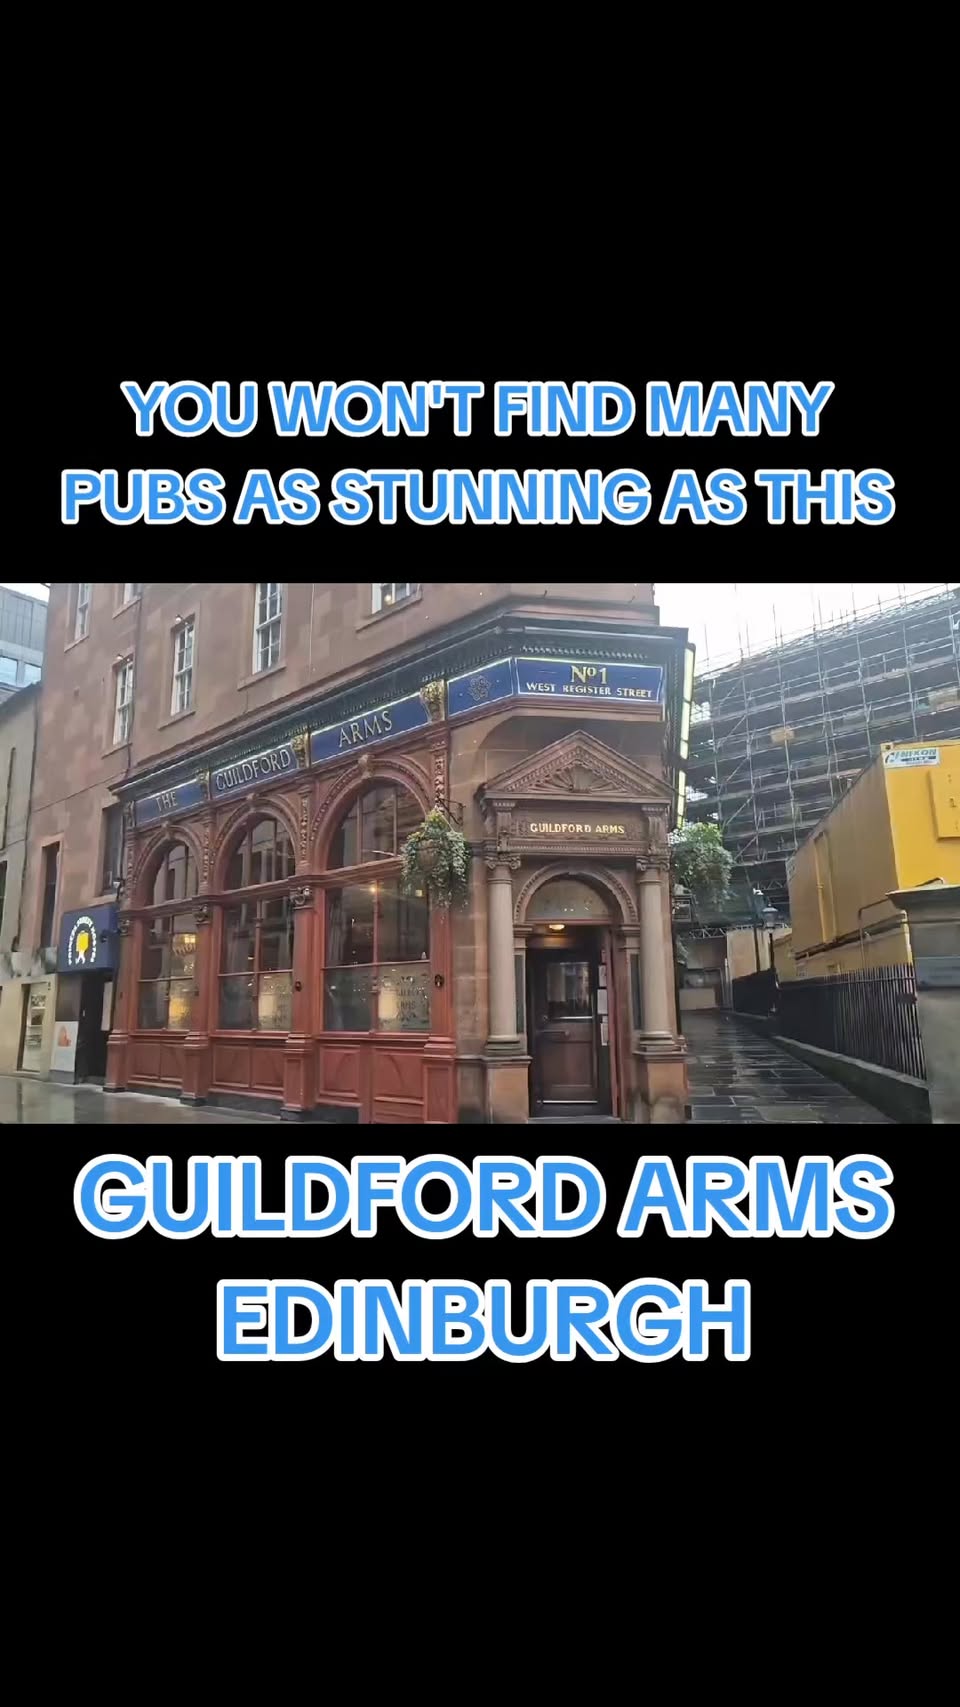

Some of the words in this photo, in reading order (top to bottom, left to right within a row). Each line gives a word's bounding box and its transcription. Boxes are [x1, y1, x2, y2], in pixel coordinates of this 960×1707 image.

[526, 682, 556, 693] WEST
[562, 685, 612, 696] REGISTER
[616, 687, 652, 698] STREET
[155, 790, 176, 812] THE
[215, 748, 292, 791] GUILDFORD
[338, 709, 394, 748] ARMS
[529, 822, 592, 833] GUILDFORD
[595, 824, 625, 834] ARMS
